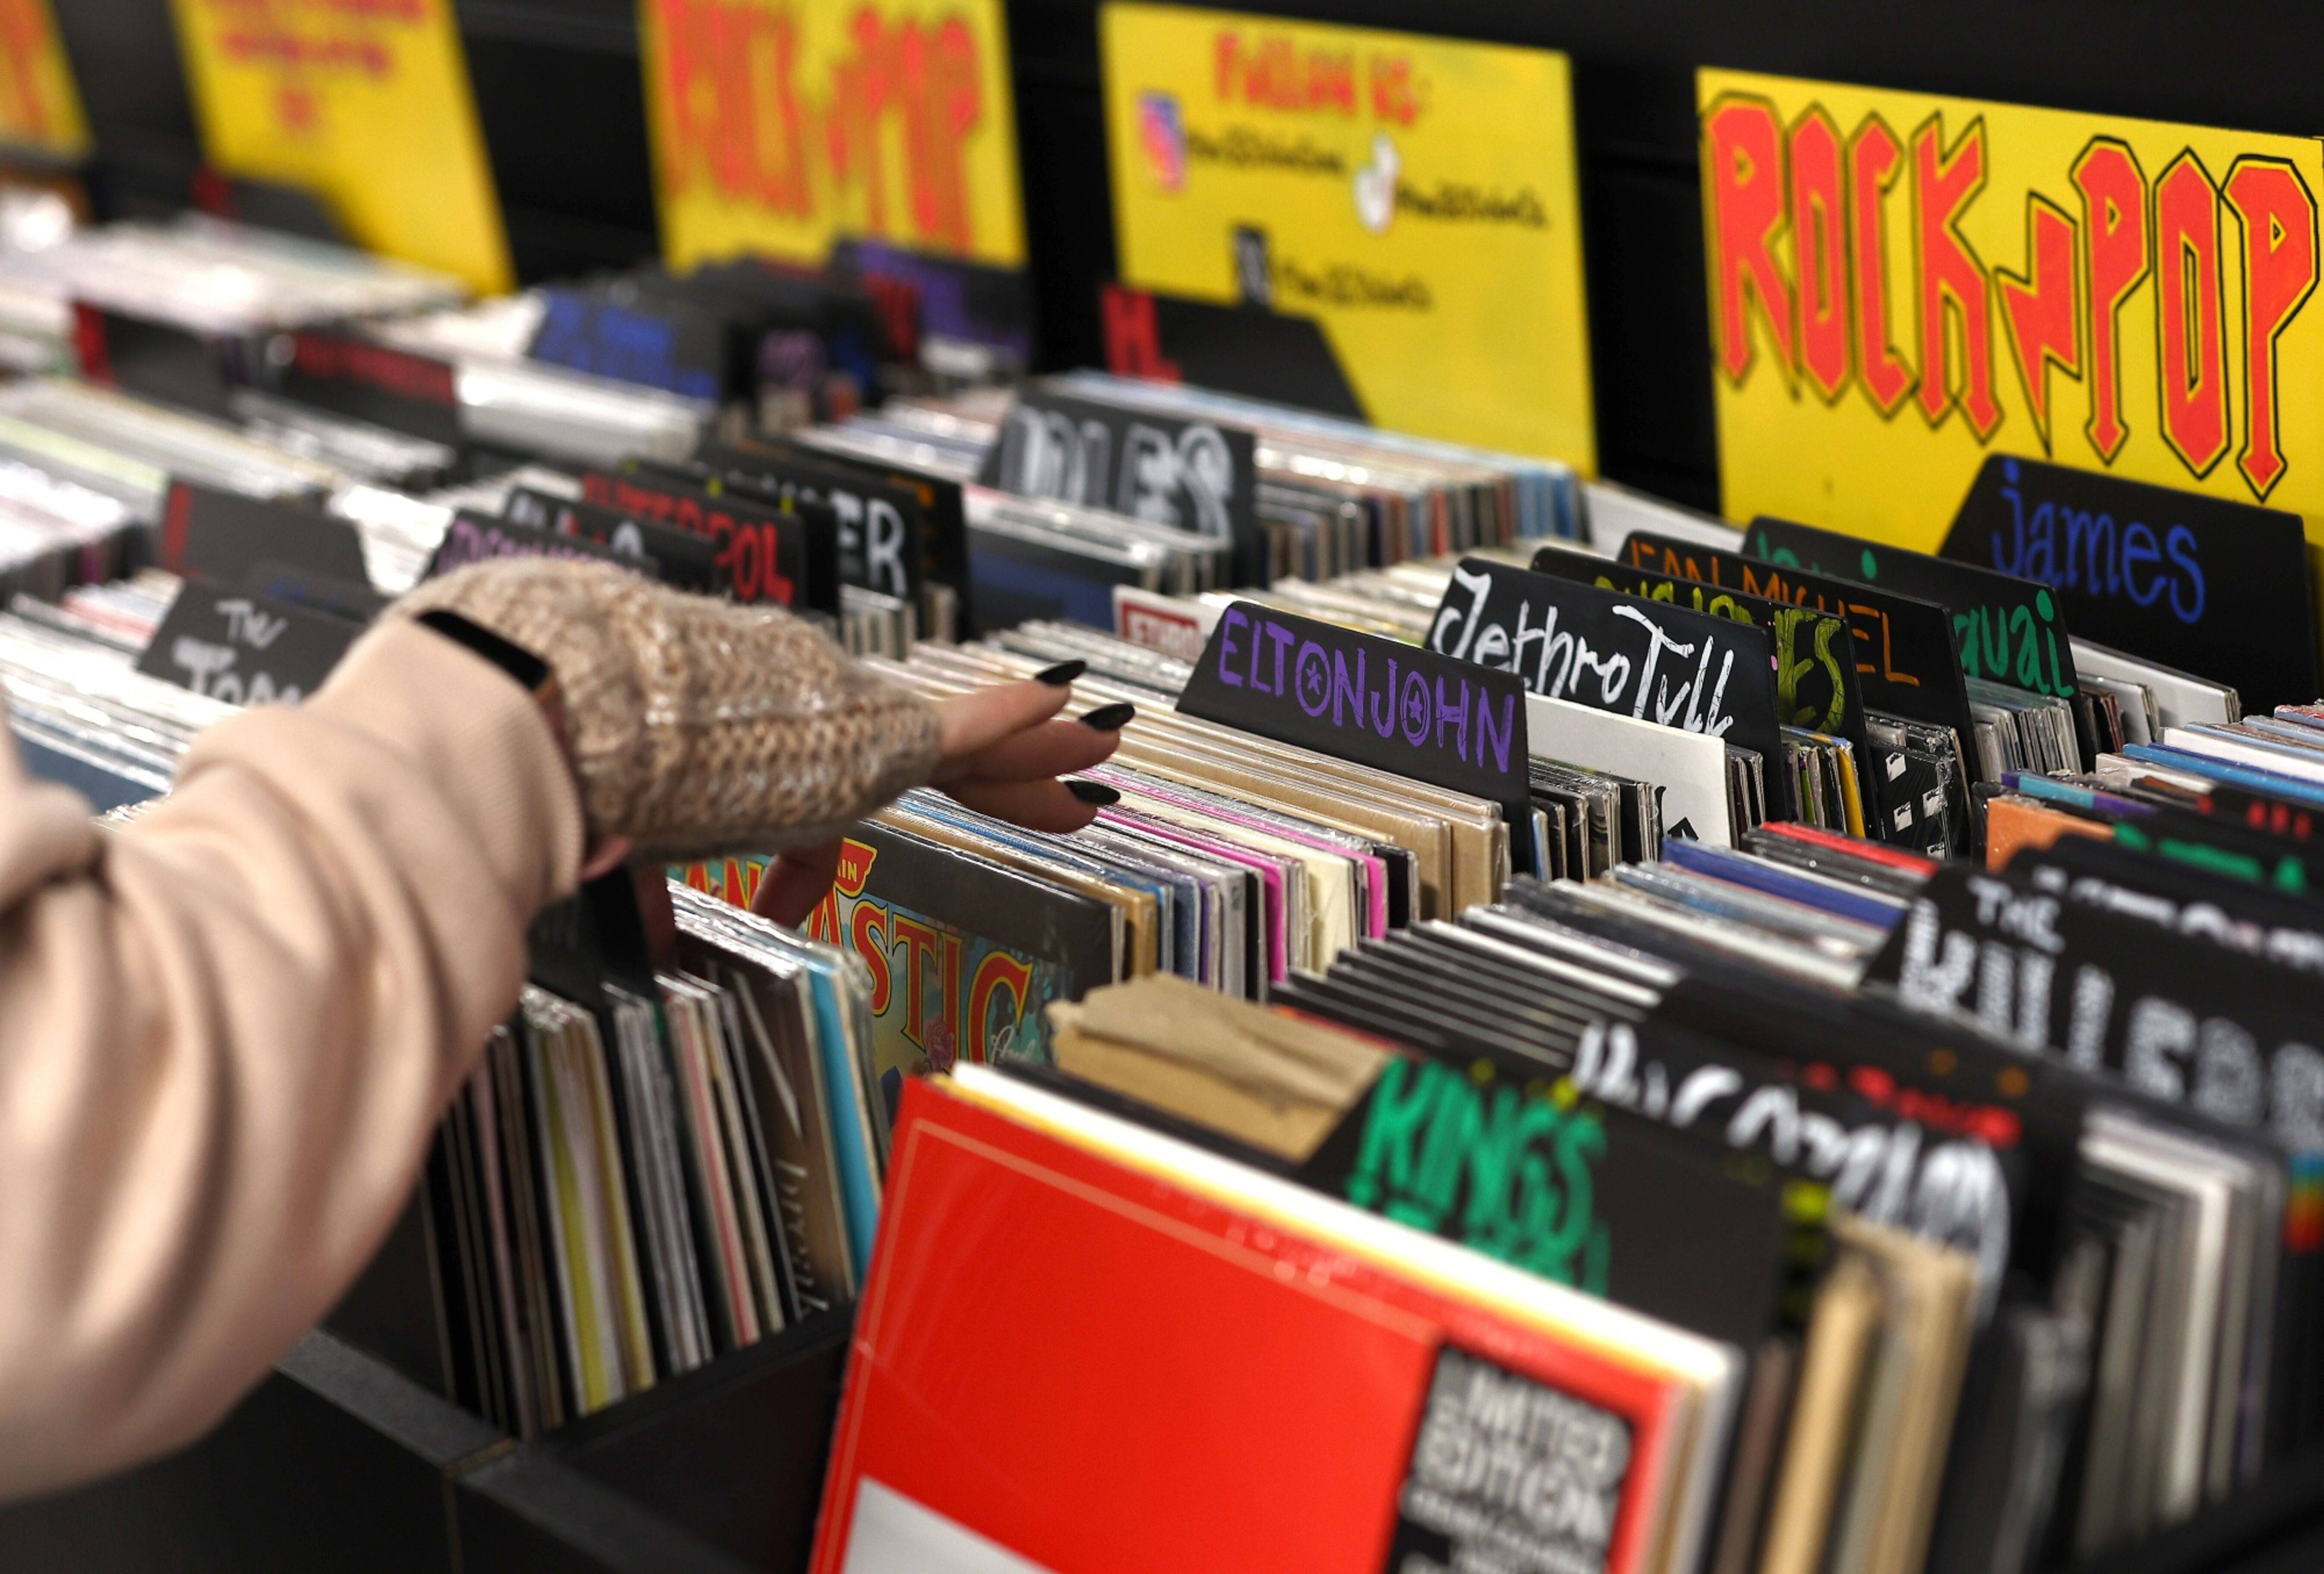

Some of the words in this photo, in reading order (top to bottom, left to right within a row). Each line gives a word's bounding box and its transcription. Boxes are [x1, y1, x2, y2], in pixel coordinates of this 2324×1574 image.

[1701, 89, 2004, 447] ROCK
[2069, 134, 2321, 505] POP
[1991, 457, 2206, 625] james
[1432, 565, 1631, 704] Jethro
[1613, 604, 1734, 737] Tull
[1966, 874, 2066, 956] THE
[1355, 1053, 1608, 1254] KINGS
